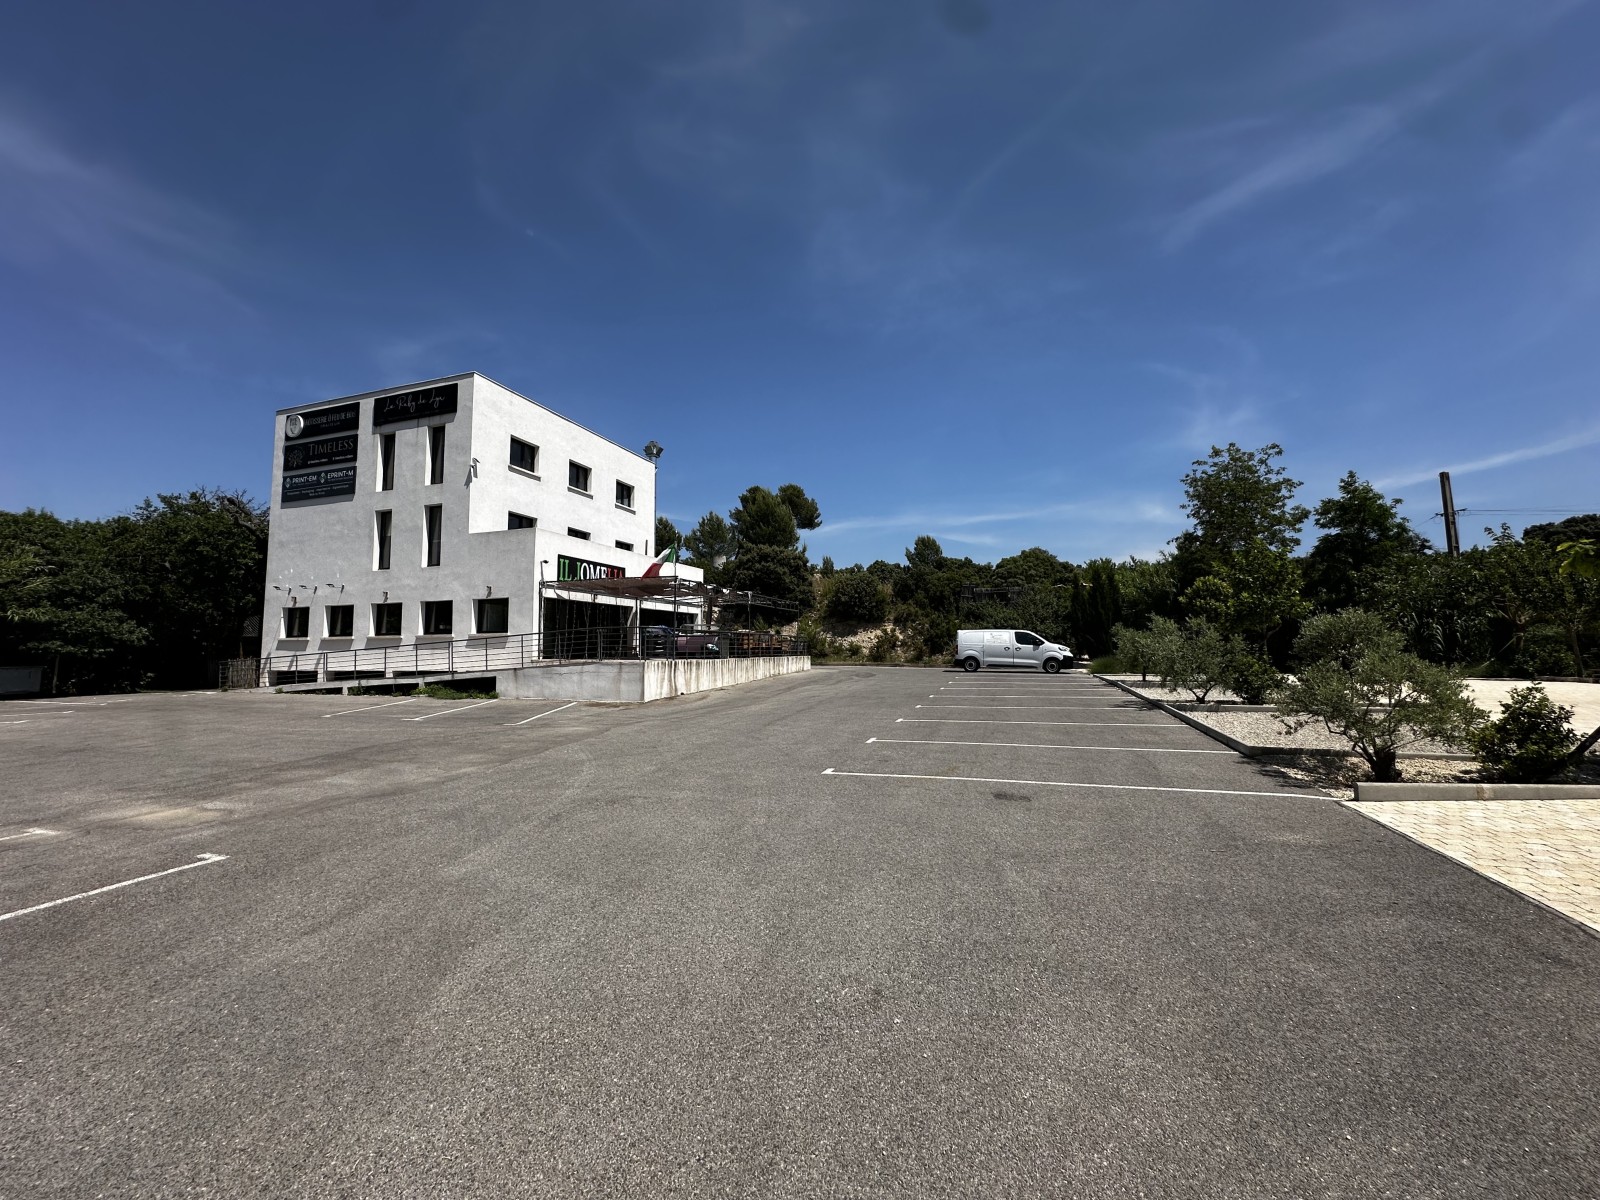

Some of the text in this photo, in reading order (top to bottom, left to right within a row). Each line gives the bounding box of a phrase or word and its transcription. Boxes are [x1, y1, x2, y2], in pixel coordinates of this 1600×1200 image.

[308, 439, 354, 455] TIMELESS
[292, 475, 317, 484] PRINT-EM
[327, 469, 354, 479] EPRINT-M
[559, 558, 572, 581] IL
